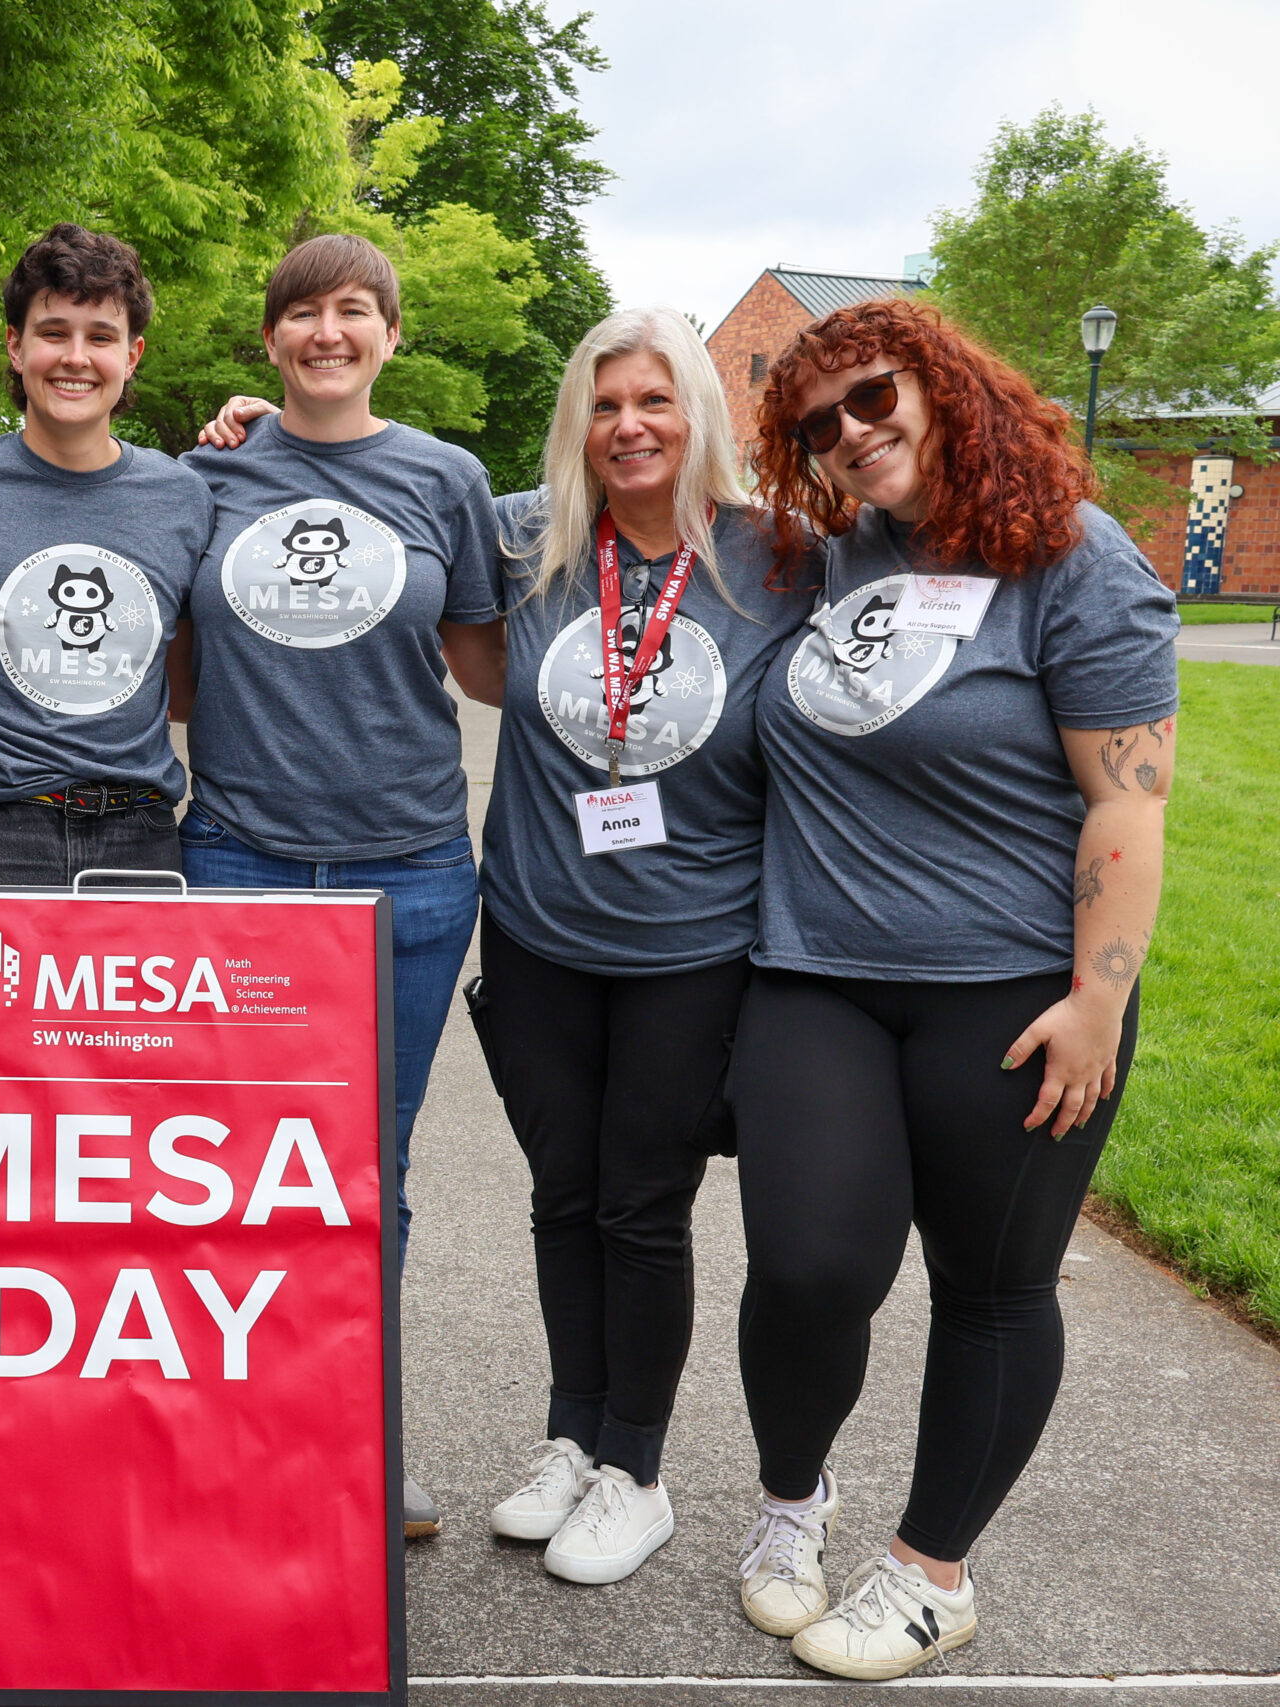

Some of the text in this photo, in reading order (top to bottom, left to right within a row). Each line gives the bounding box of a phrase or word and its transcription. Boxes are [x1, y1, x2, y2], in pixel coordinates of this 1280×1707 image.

[259, 509, 289, 526] MATH
[338, 504, 398, 544] ENGINEERING
[22, 551, 50, 571] MATH
[97, 549, 154, 603] ENGINEERING
[656, 543, 695, 622] SW WA MESA
[935, 580, 962, 589] MESA
[249, 584, 375, 611] MESA
[844, 584, 873, 603] MATH
[227, 591, 292, 643] ACHIEVEMENT
[291, 613, 339, 621] WASHINGTON
[919, 600, 961, 612] Kirstin
[343, 606, 387, 640] SCIENCE
[930, 622, 957, 630] Support
[607, 628, 618, 650] SW
[671, 615, 722, 672] ENGINEERING
[20, 648, 134, 678] MESA
[608, 651, 621, 674] WA
[1, 651, 61, 709] ACHIEVEMENT
[62, 679, 106, 687] WASHINGTON
[109, 673, 142, 707] SCIENCE
[789, 656, 819, 721] ACHIEVEMENT
[800, 656, 893, 707] MESA
[540, 690, 593, 760] ACHIEVEMENT
[859, 703, 904, 733] SCIENCE
[643, 744, 694, 773] SCIENCE
[600, 792, 634, 807] MESA
[601, 816, 641, 832] Anna
[611, 836, 636, 846] She/her
[225, 958, 252, 969] Math
[33, 954, 229, 1013] MESA
[231, 973, 291, 987] Engineering
[236, 988, 275, 999] Science
[241, 1003, 308, 1015] Achievement
[33, 1030, 174, 1052] SW Washington
